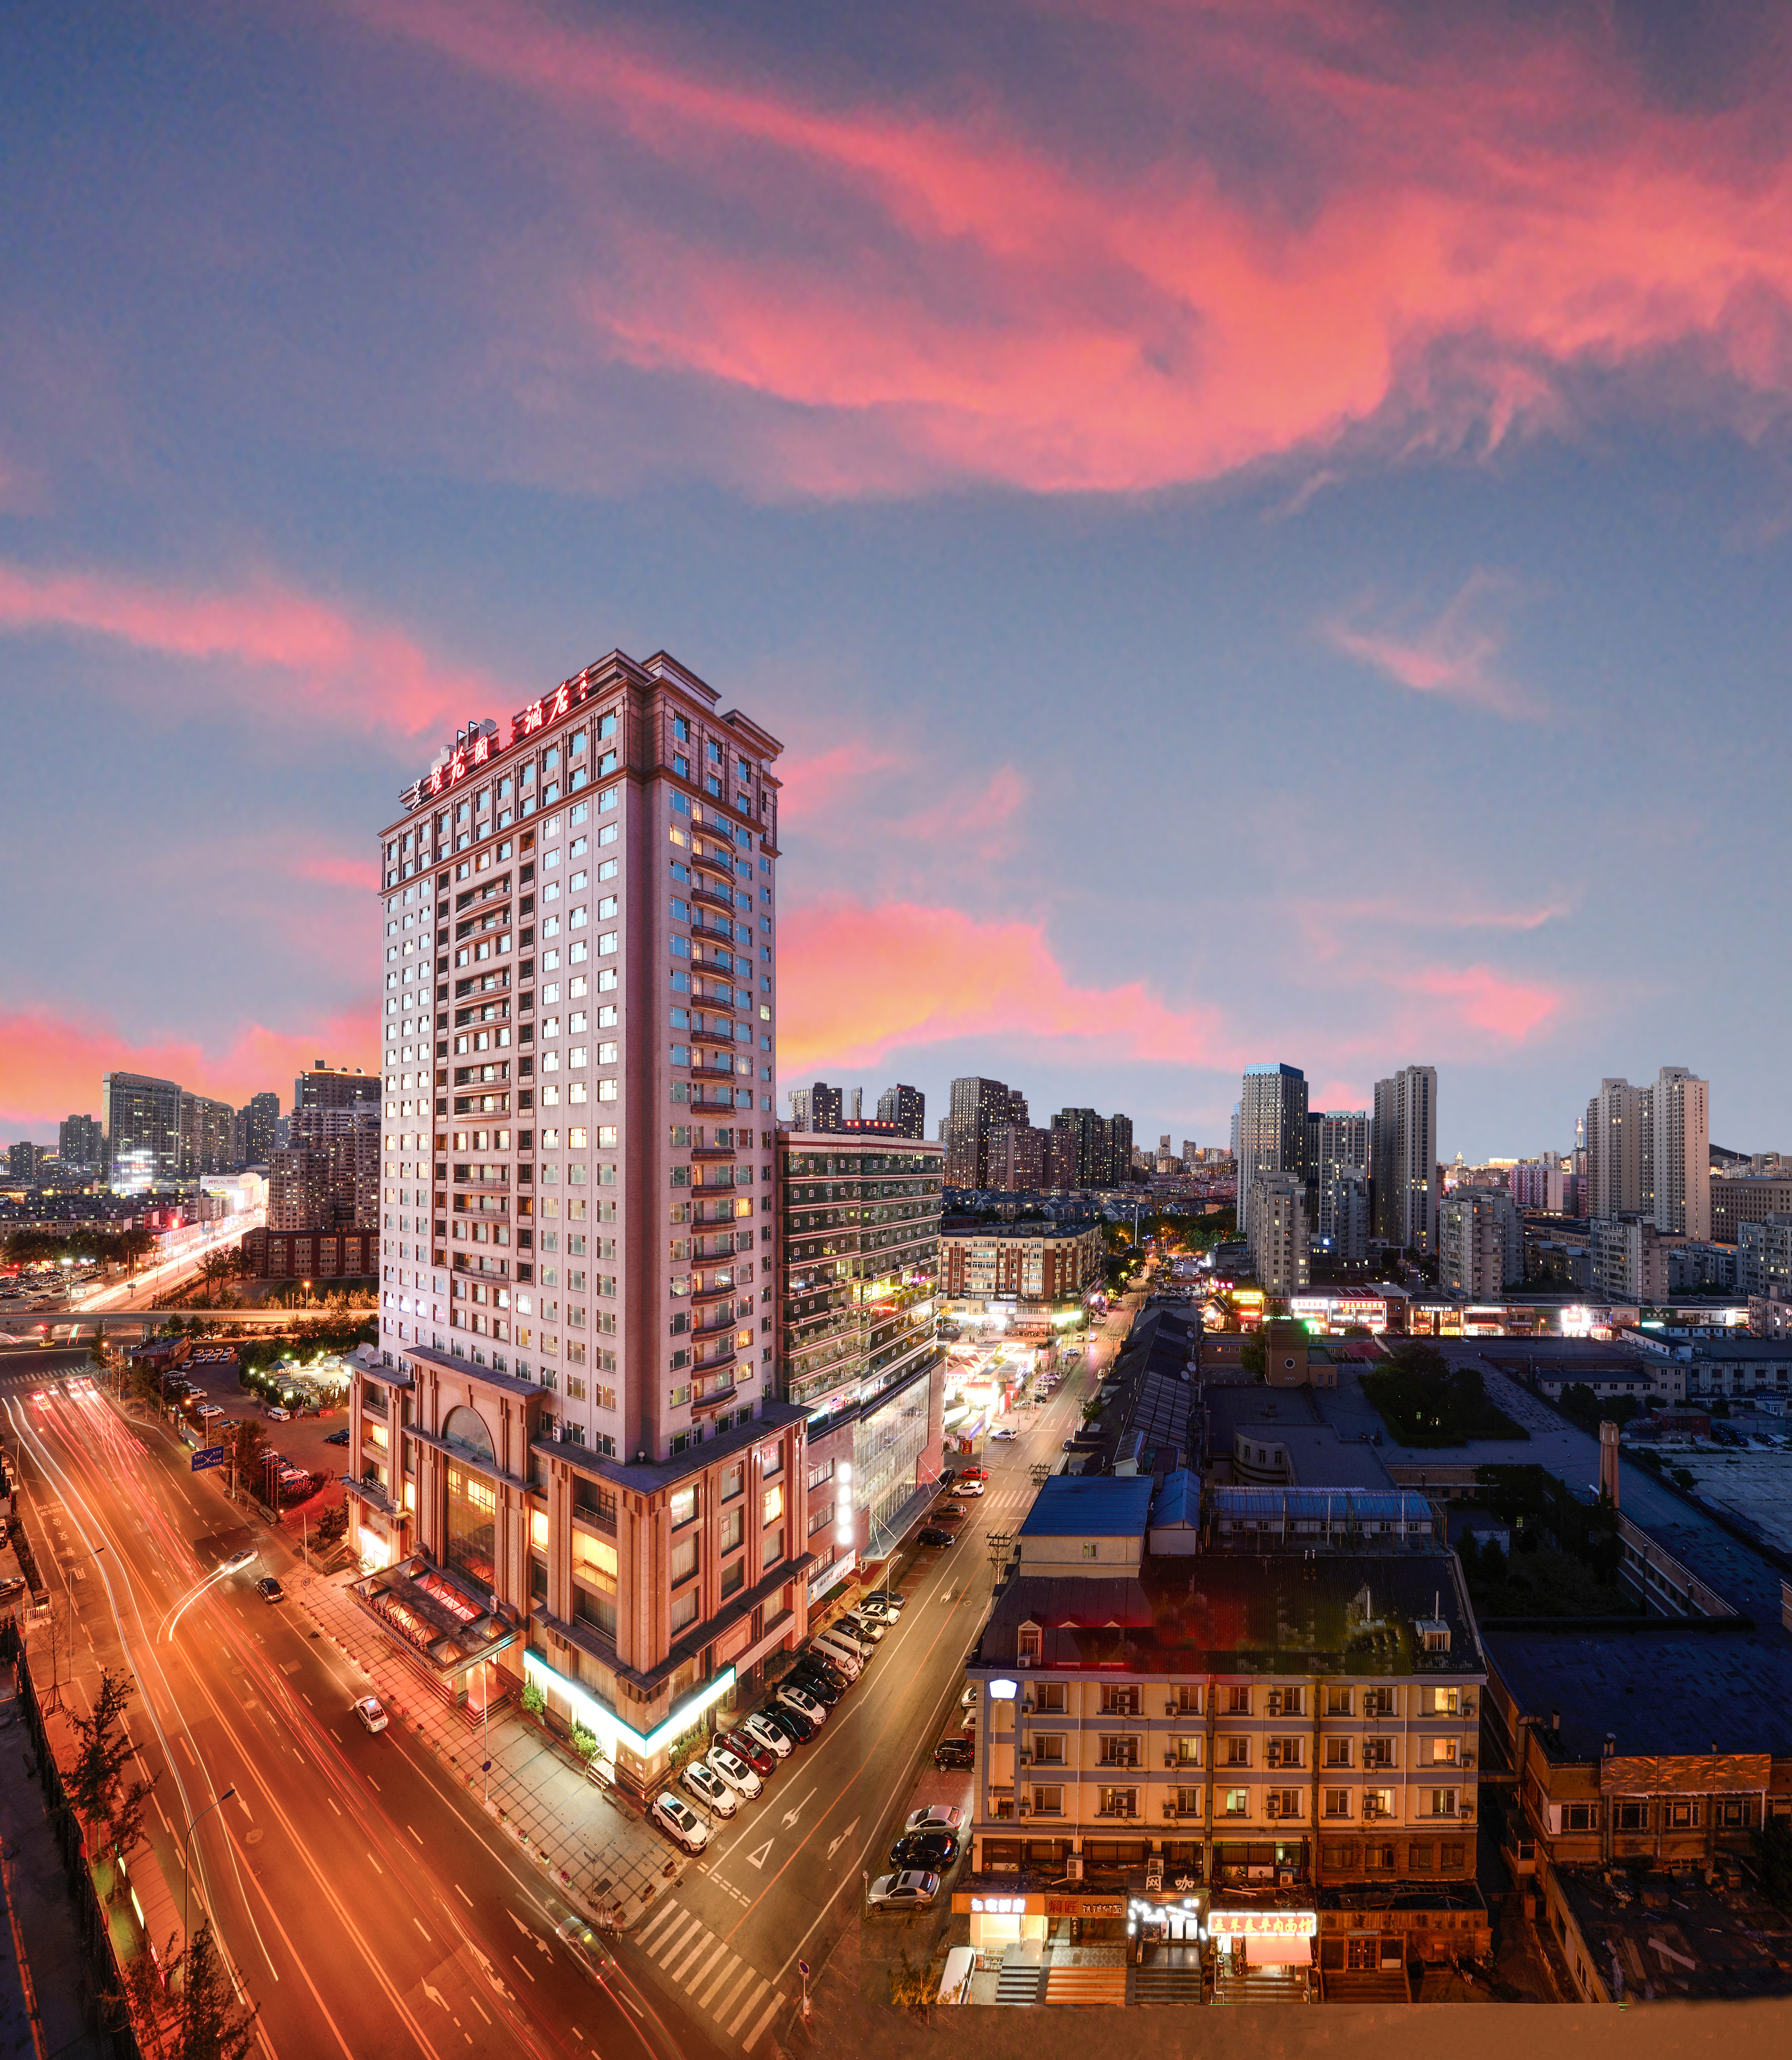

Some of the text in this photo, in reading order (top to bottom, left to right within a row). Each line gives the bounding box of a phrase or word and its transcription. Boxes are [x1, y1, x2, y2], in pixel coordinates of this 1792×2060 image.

[41, 1507, 64, 1516] 6:30-8:30
[383, 1625, 410, 1654] INTERNATIONAL
[413, 1653, 424, 1666] HOTEL
[1146, 1874, 1195, 1892] 网咖
[1048, 1899, 1078, 1913] 焖匠
